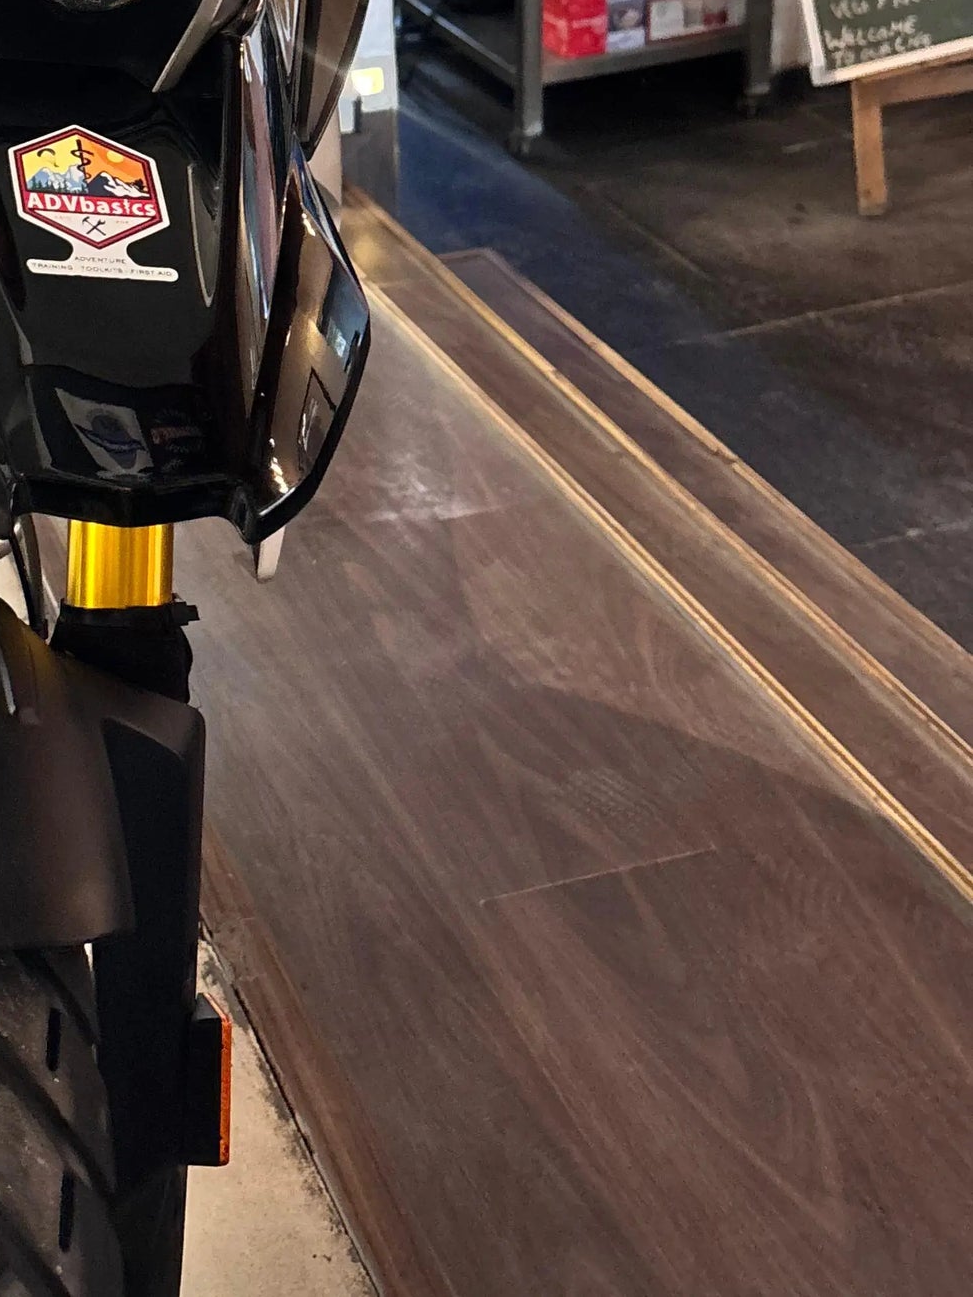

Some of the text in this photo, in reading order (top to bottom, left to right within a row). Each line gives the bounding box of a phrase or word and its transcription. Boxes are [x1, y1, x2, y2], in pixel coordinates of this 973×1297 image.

[27, 192, 157, 218] ADVbasics
[74, 255, 127, 265] ADVENTURE
[32, 262, 74, 271] TRAINING
